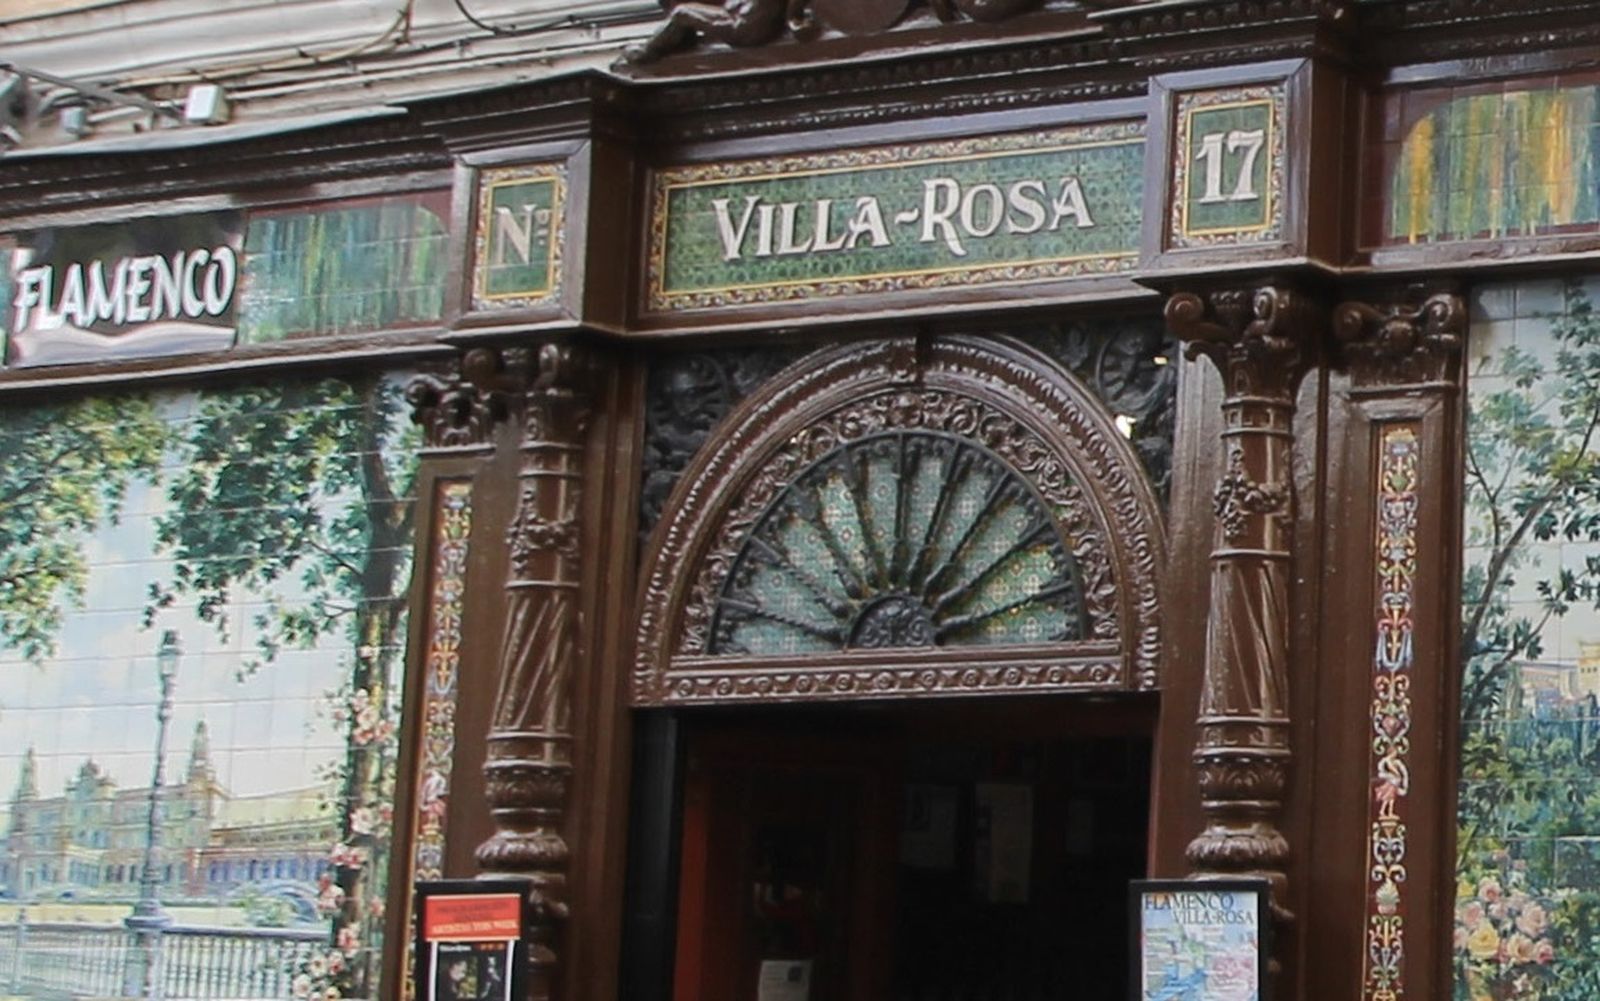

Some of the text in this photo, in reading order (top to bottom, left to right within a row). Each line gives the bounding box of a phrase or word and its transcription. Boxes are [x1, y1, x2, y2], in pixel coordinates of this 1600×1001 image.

[1195, 129, 1265, 203] 17
[712, 177, 1095, 261] VILLA-ROSA
[13, 246, 236, 333] FLAMENCO
[1144, 892, 1234, 910] FLAMENCO
